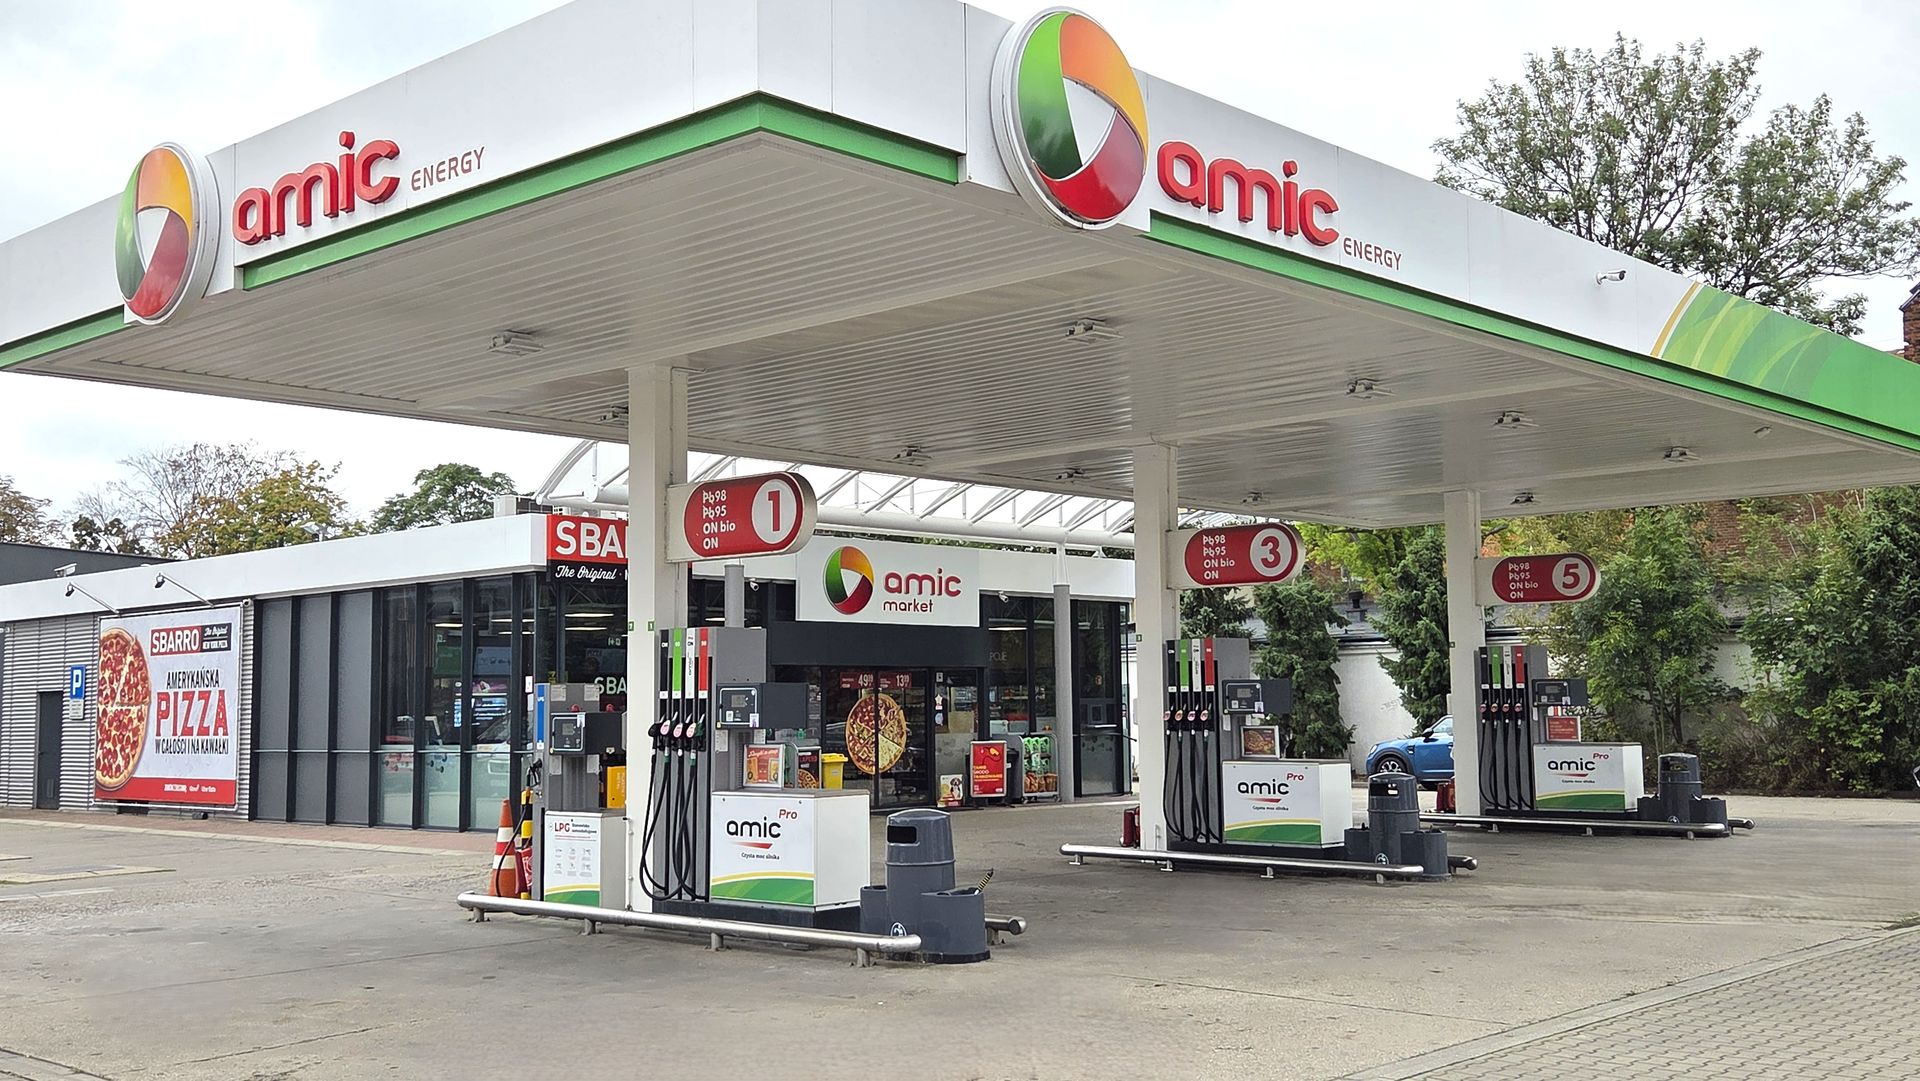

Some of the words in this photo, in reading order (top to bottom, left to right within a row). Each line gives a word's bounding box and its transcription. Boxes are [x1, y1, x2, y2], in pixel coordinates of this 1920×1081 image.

[232, 131, 400, 245] amic
[411, 147, 484, 191] ENERGY
[1158, 142, 1339, 246] amic
[1343, 238, 1402, 270] ENERGY
[703, 490, 726, 504] Pb98
[703, 505, 726, 520] Pb95
[768, 490, 780, 532] 1
[703, 522, 718, 534] ON
[720, 520, 736, 532] bio
[556, 520, 628, 558] SBA
[703, 537, 718, 549] ON
[1261, 535, 1281, 568] 3
[1204, 559, 1218, 568] ON
[1221, 558, 1235, 567] bio
[555, 565, 574, 578] The
[577, 566, 617, 582] Original
[884, 568, 961, 597] amic
[1204, 570, 1219, 579] ON
[1562, 563, 1580, 589] 5
[883, 599, 933, 612] market
[152, 629, 199, 653] SBARRO
[72, 669, 82, 695] P
[166, 666, 219, 689] AMERYKAŃSKA
[156, 690, 228, 736] PIZZA
[1548, 758, 1595, 771] amic
[1238, 779, 1289, 795] amic
[779, 809, 798, 819] Pro
[555, 822, 570, 832] LPG
[726, 816, 782, 838] amic
